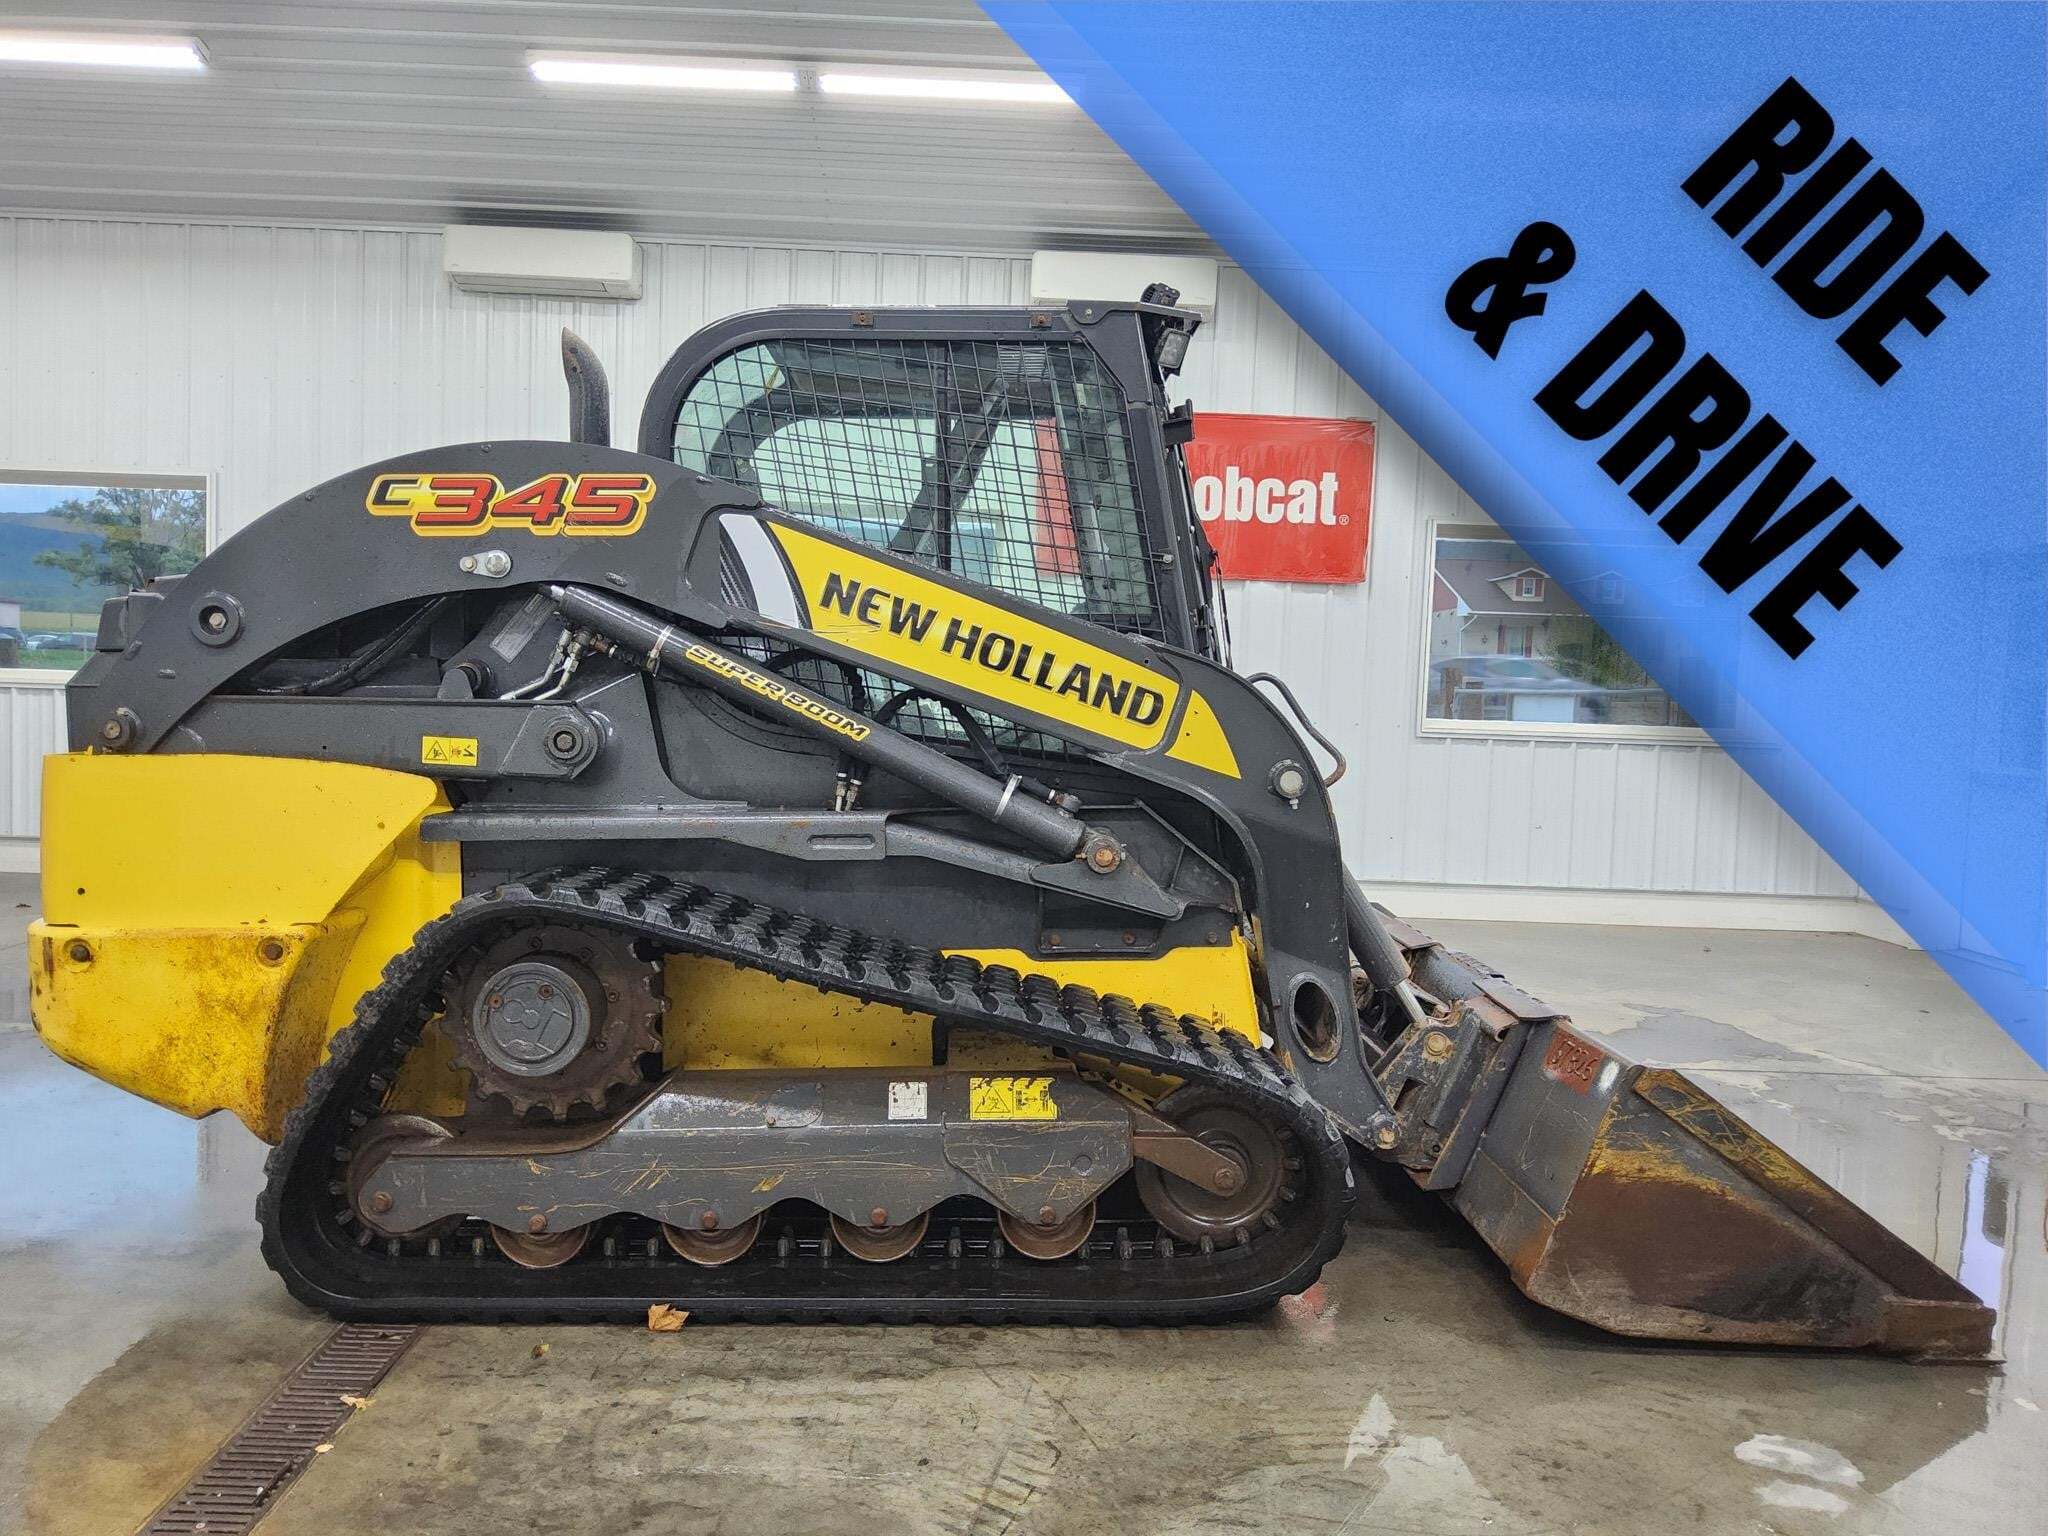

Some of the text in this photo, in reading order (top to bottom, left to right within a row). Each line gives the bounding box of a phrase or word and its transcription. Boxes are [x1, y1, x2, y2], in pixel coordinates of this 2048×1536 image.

[367, 474, 655, 535] C345
[687, 645, 870, 741] SUPER BOOM
[819, 572, 1165, 728] NEW HOLLAND
